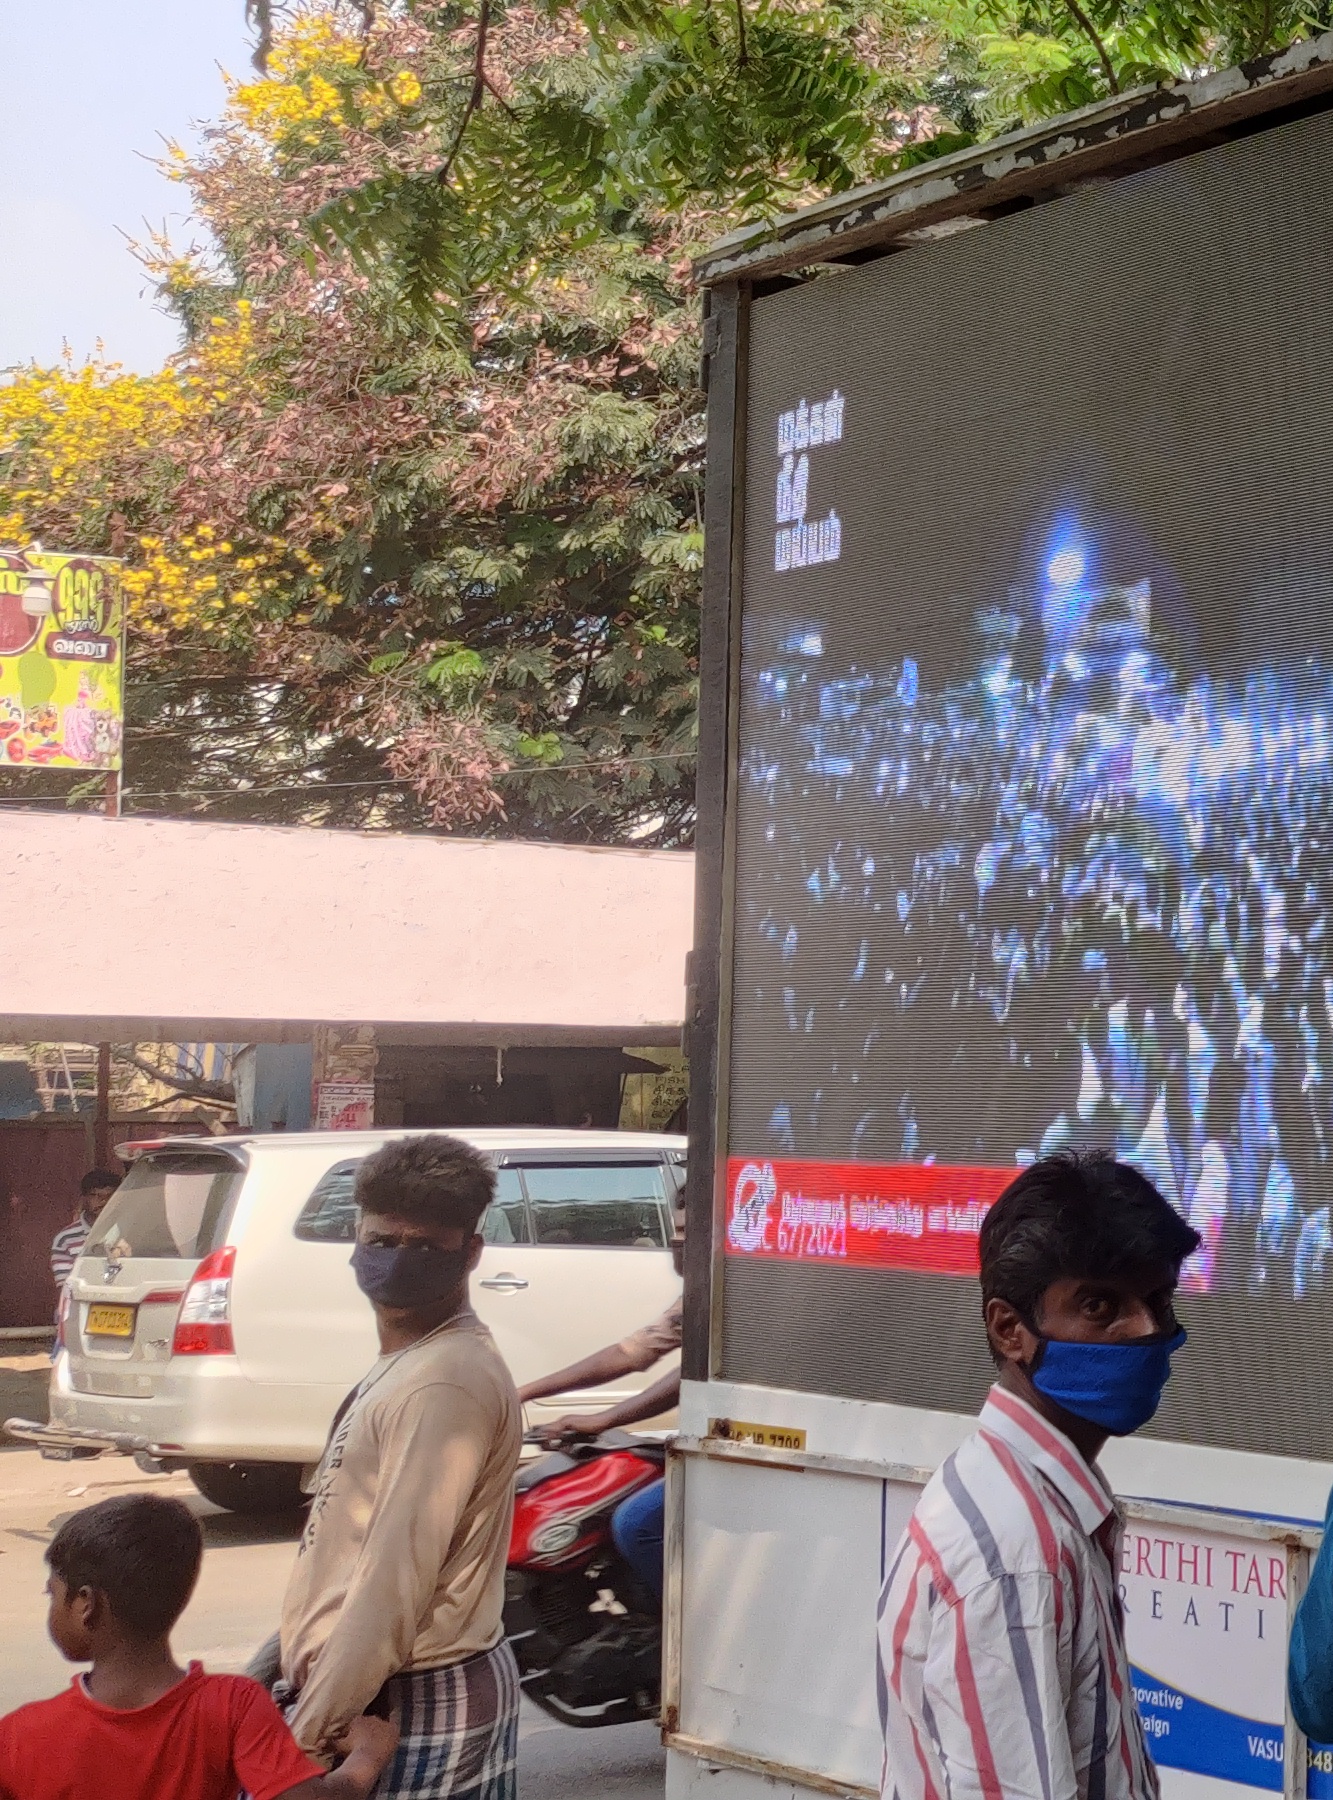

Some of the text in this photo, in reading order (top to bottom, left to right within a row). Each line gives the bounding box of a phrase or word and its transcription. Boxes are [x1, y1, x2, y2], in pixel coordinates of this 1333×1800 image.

[53, 639, 110, 659] வரை
[777, 1219, 848, 1258] 67/2021
[1224, 1549, 1287, 1600] TAR
[1139, 1714, 1171, 1738] aign
[1247, 1735, 1284, 1762] VASU
